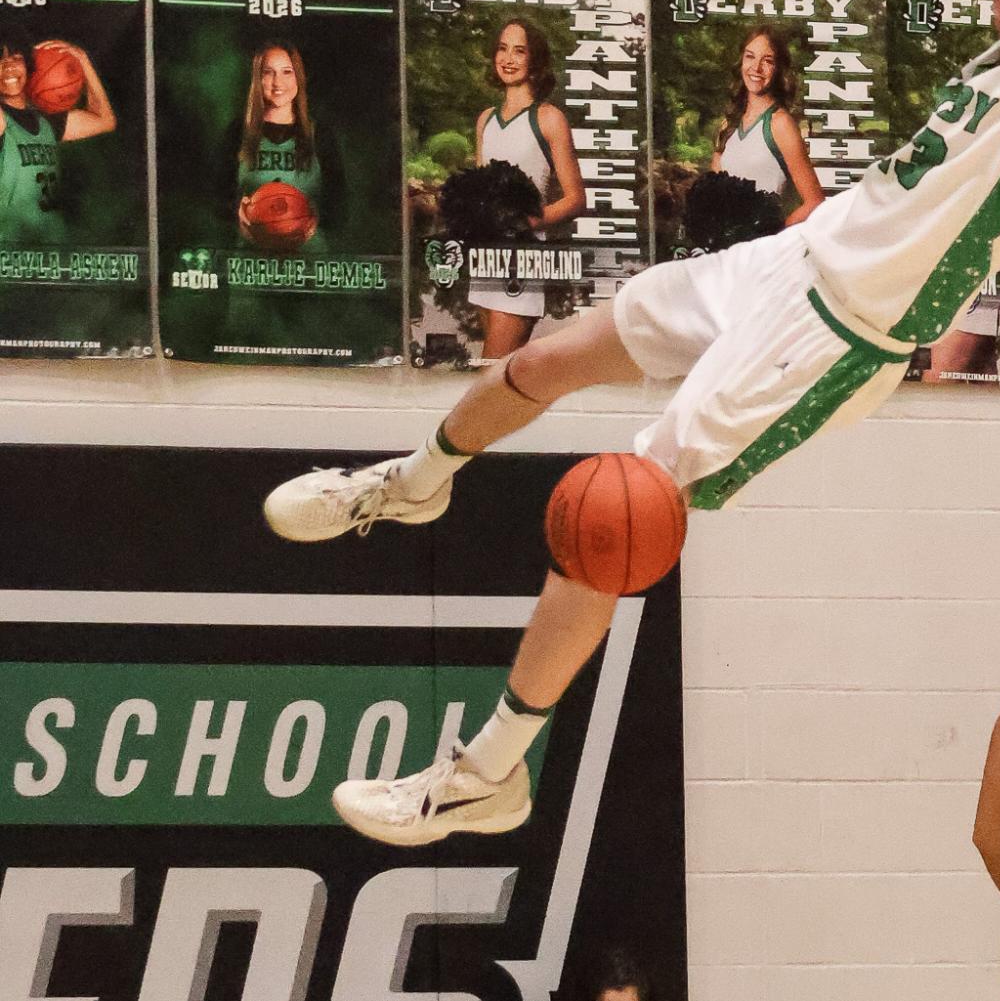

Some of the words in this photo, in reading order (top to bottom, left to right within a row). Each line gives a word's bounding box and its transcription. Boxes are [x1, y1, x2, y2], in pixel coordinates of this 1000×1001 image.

[565, 10, 642, 320] PANTHERETT
[70, 253, 138, 281] ASKEW
[227, 258, 305, 285] KARLIE
[314, 261, 386, 288] DEMEL
[469, 248, 512, 278] CARLY
[516, 249, 582, 280] BERGLIND
